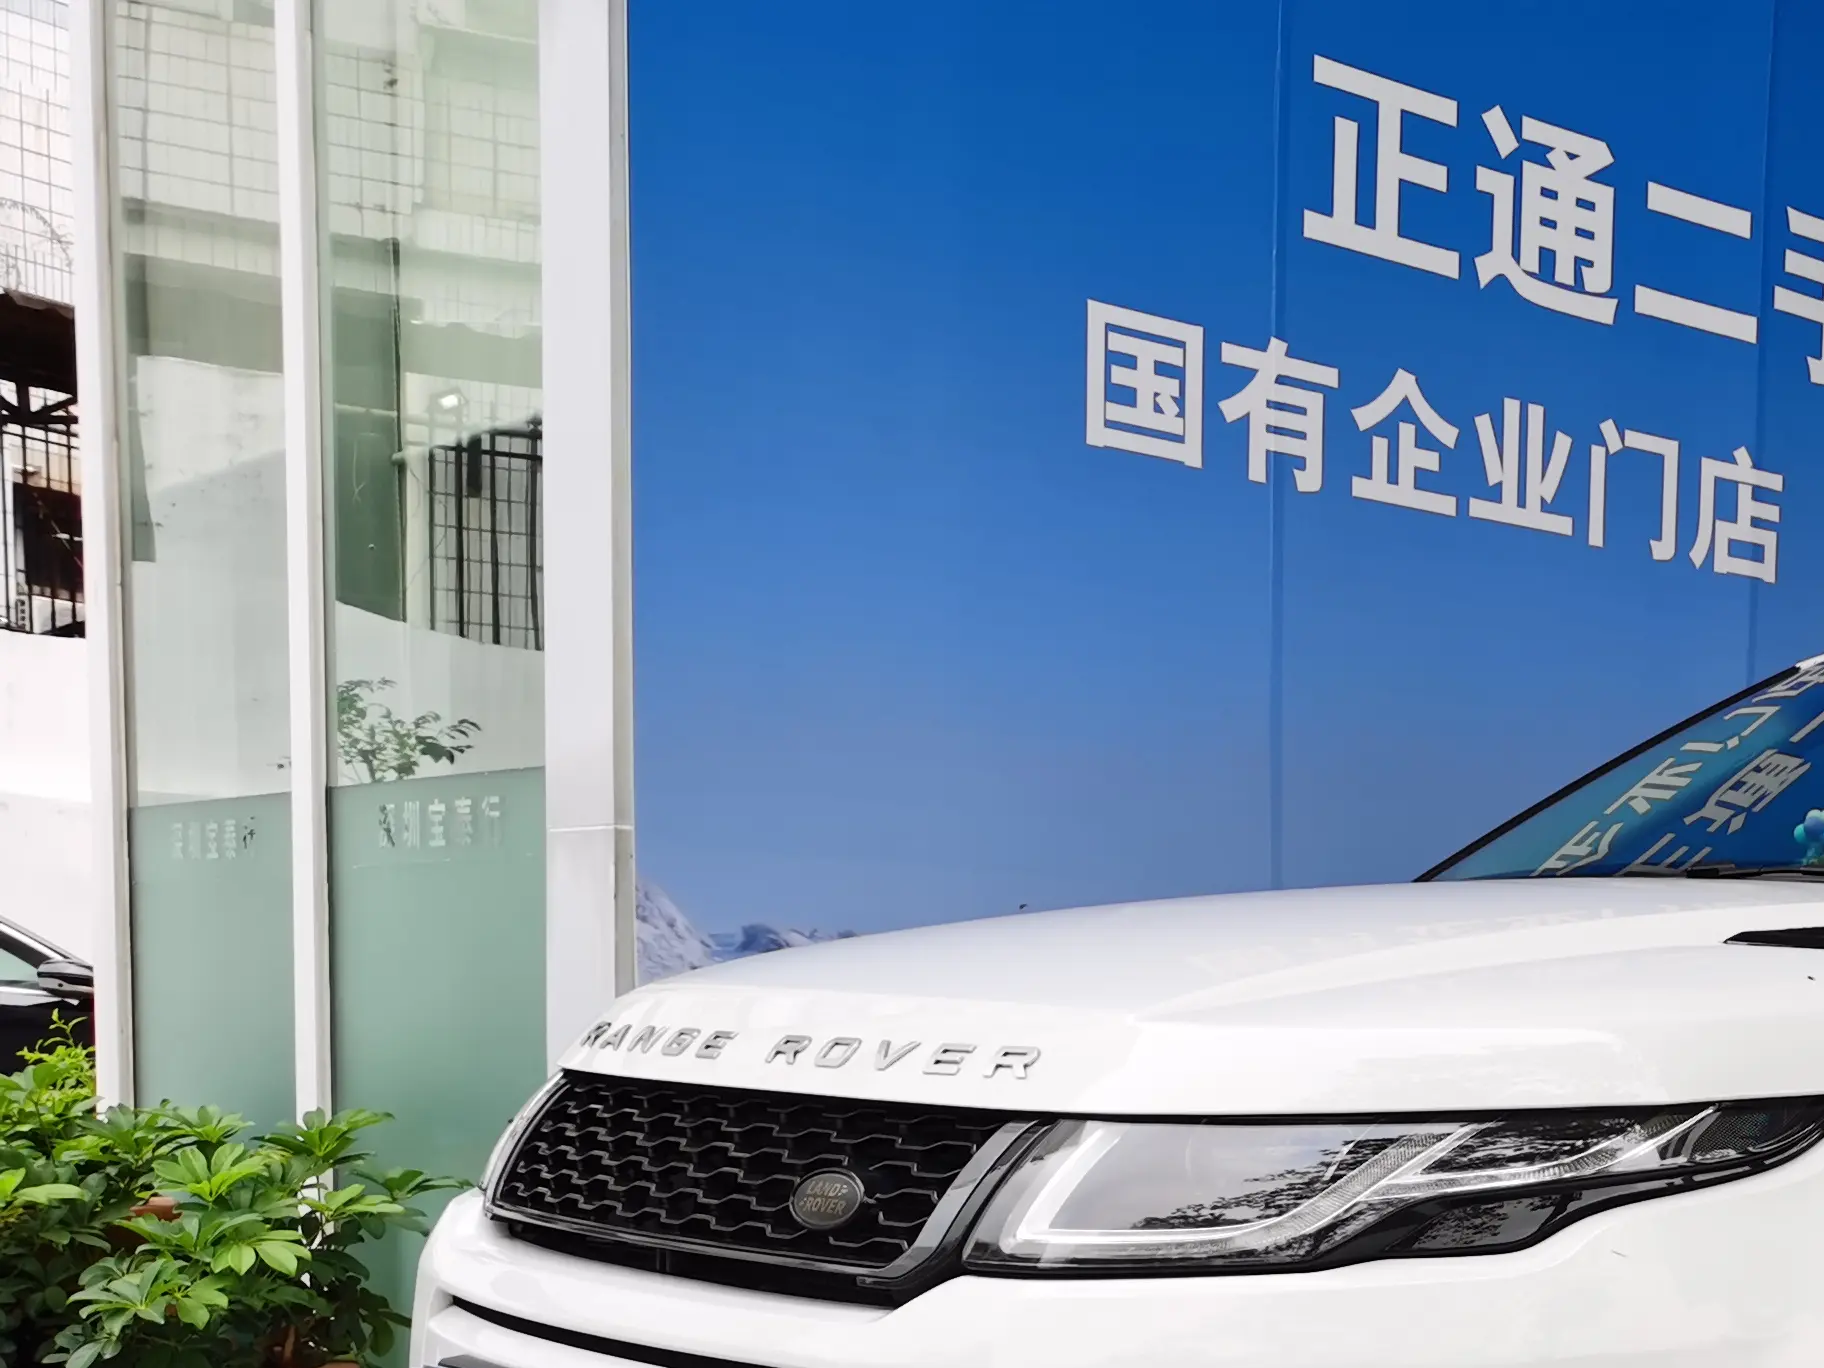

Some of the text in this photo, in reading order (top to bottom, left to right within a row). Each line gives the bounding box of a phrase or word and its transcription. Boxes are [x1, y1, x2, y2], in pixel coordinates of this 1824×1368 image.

[1085, 299, 1784, 585] 国有企业门店
[579, 1020, 1041, 1080] RANGE ROVER
[802, 1196, 846, 1215] ROVER
[806, 1180, 841, 1197] LAND
